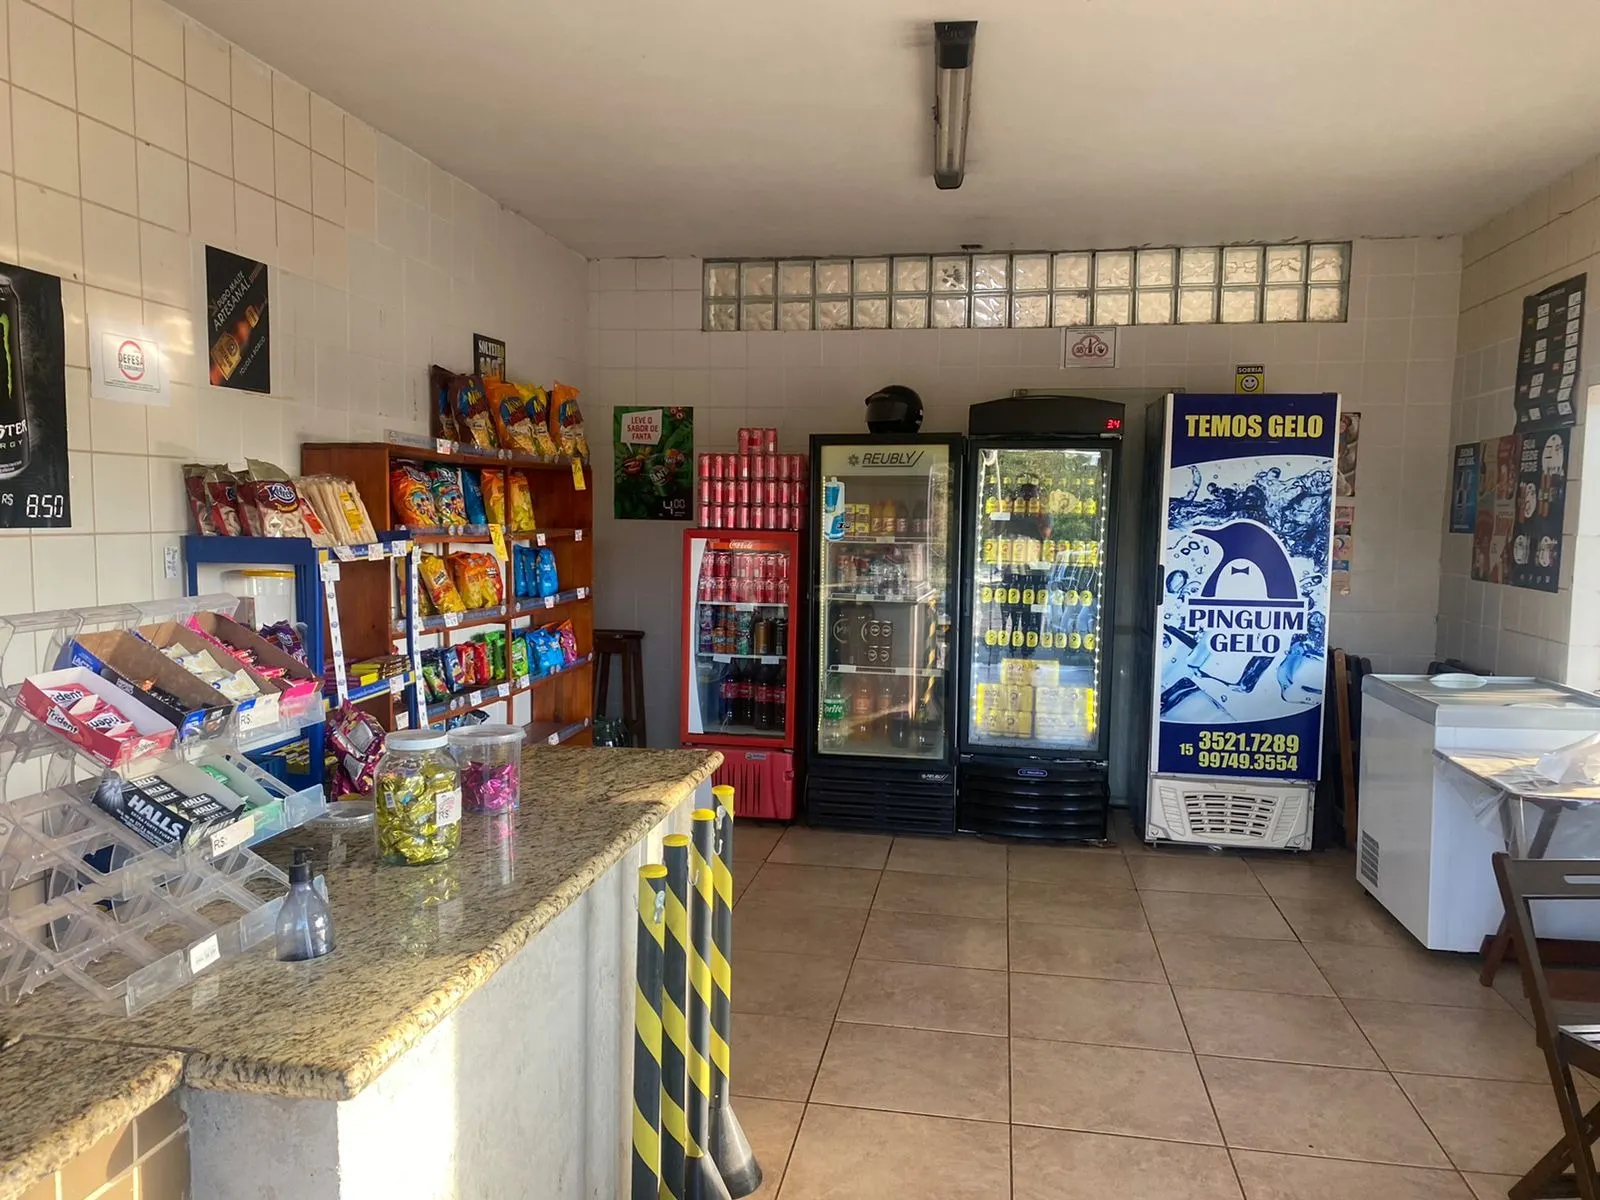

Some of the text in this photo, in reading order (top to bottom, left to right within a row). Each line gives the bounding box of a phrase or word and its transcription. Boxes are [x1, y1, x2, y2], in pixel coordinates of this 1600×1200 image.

[213, 280, 251, 331] ARTESANAL
[627, 425, 658, 433] SABOR DE
[631, 416, 653, 424] LEVE O
[1185, 414, 1324, 438] TEMOS GELO
[631, 432, 652, 441] FANTA
[862, 451, 917, 465] REUBLY
[26, 494, 64, 518] 8.50
[1188, 608, 1305, 630] PINGUIM
[1210, 633, 1280, 653] GELO
[47, 708, 79, 734] Trident
[1179, 743, 1194, 756] 15
[1198, 731, 1300, 754] 3521.7289
[1198, 752, 1298, 771] 99749.3554
[182, 794, 209, 808] HALLS
[193, 802, 220, 816] HALLS
